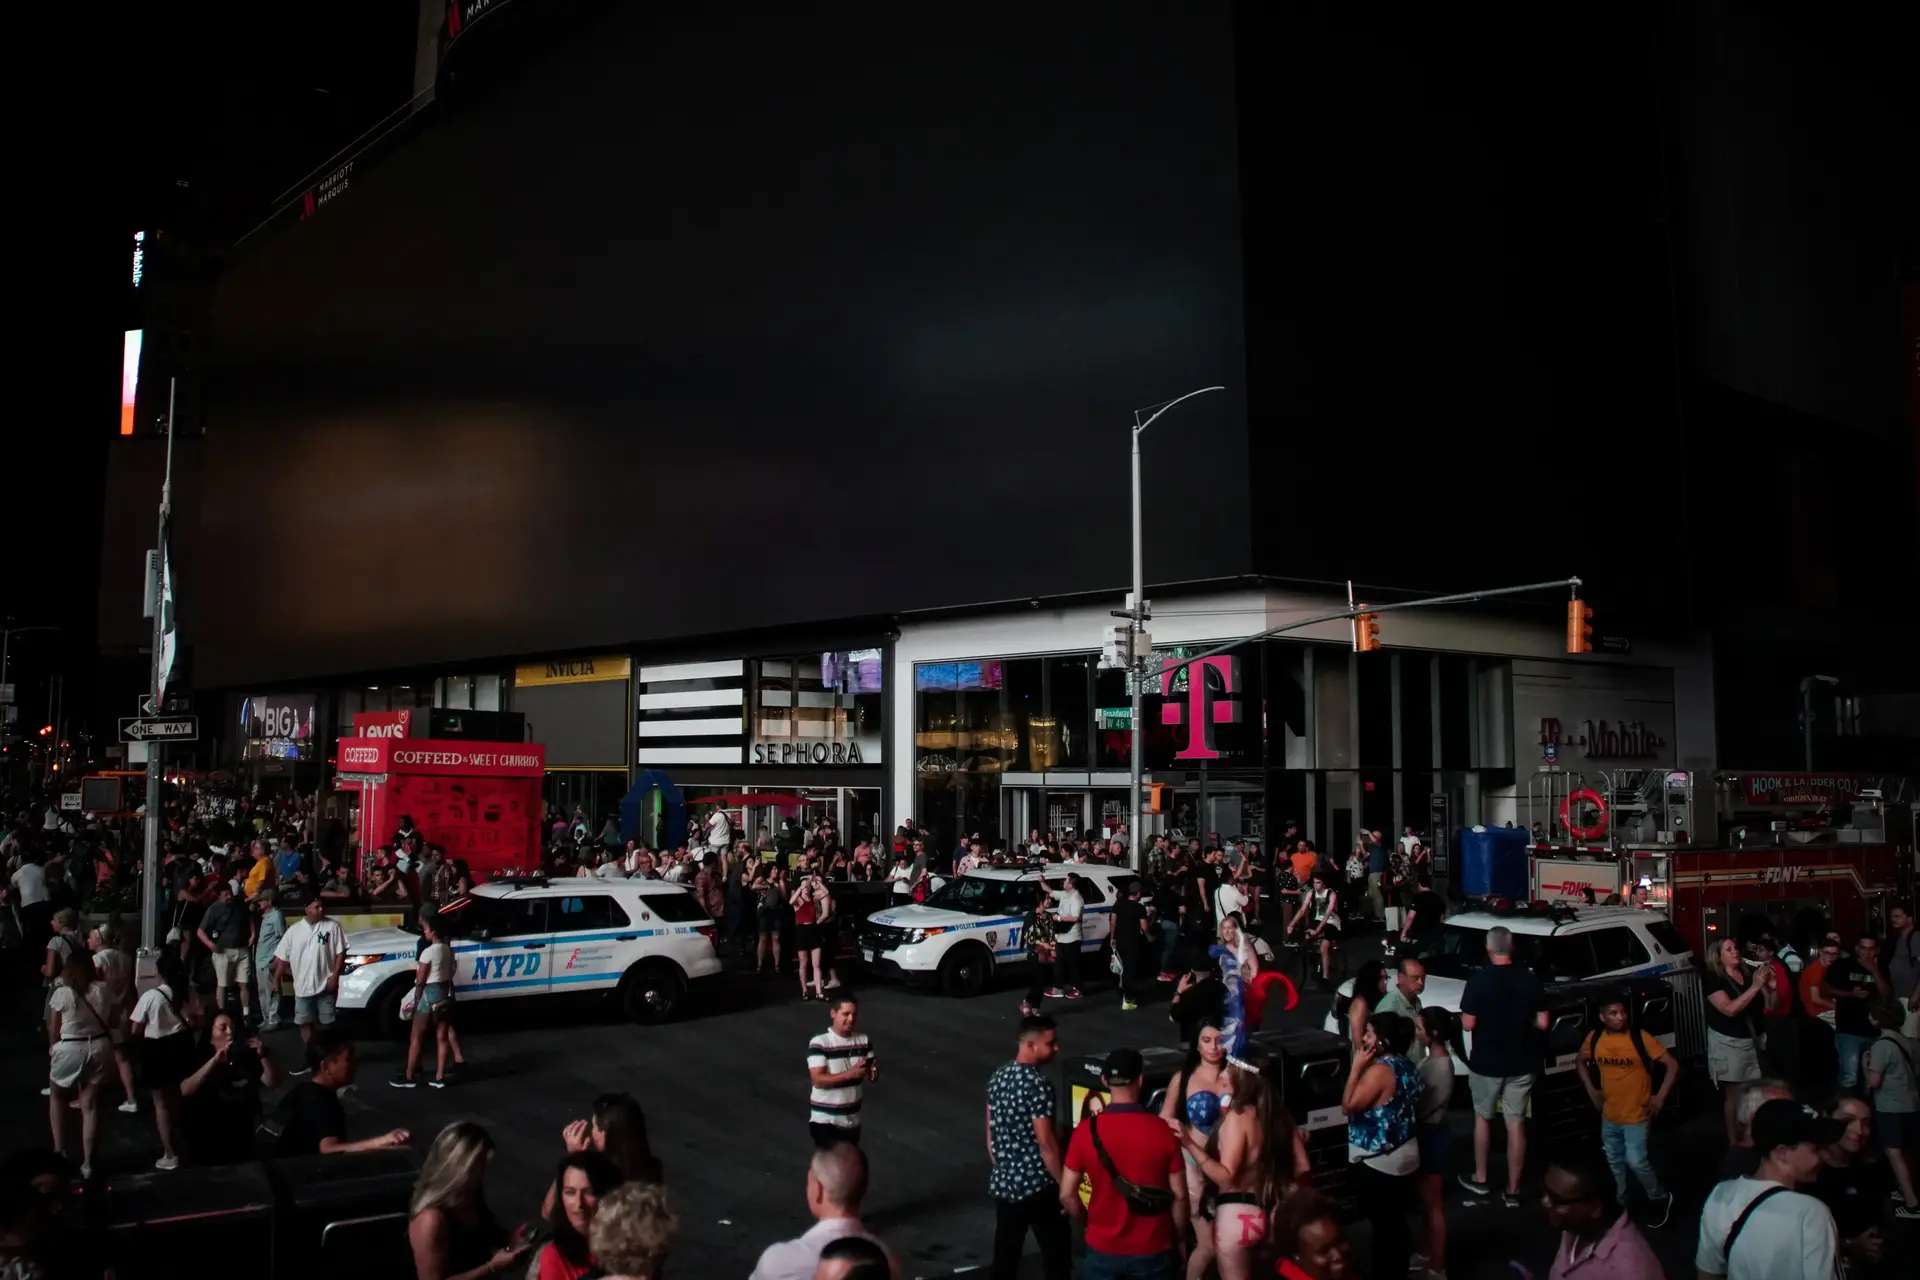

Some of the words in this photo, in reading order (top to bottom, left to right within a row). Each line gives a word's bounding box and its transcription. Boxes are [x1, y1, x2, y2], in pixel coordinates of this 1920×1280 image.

[319, 161, 354, 193] MARRIOTT
[318, 178, 349, 208] MARQUIS
[545, 660, 595, 679] INVICTA
[131, 724, 154, 735] ONE
[164, 723, 188, 734] WAY
[265, 706, 292, 737] BIG
[1107, 718, 1114, 729] W
[344, 747, 379, 763] COFFEED
[393, 750, 463, 766] COFFEED
[468, 754, 498, 767] SWEET
[499, 754, 540, 768] CHURROS
[755, 741, 861, 764] SEPHORA
[1751, 777, 1783, 797] HOOK
[1765, 865, 1802, 884] FDNY
[955, 922, 977, 931] POLICE
[397, 950, 416, 960] POLI
[471, 952, 542, 981] NYPD
